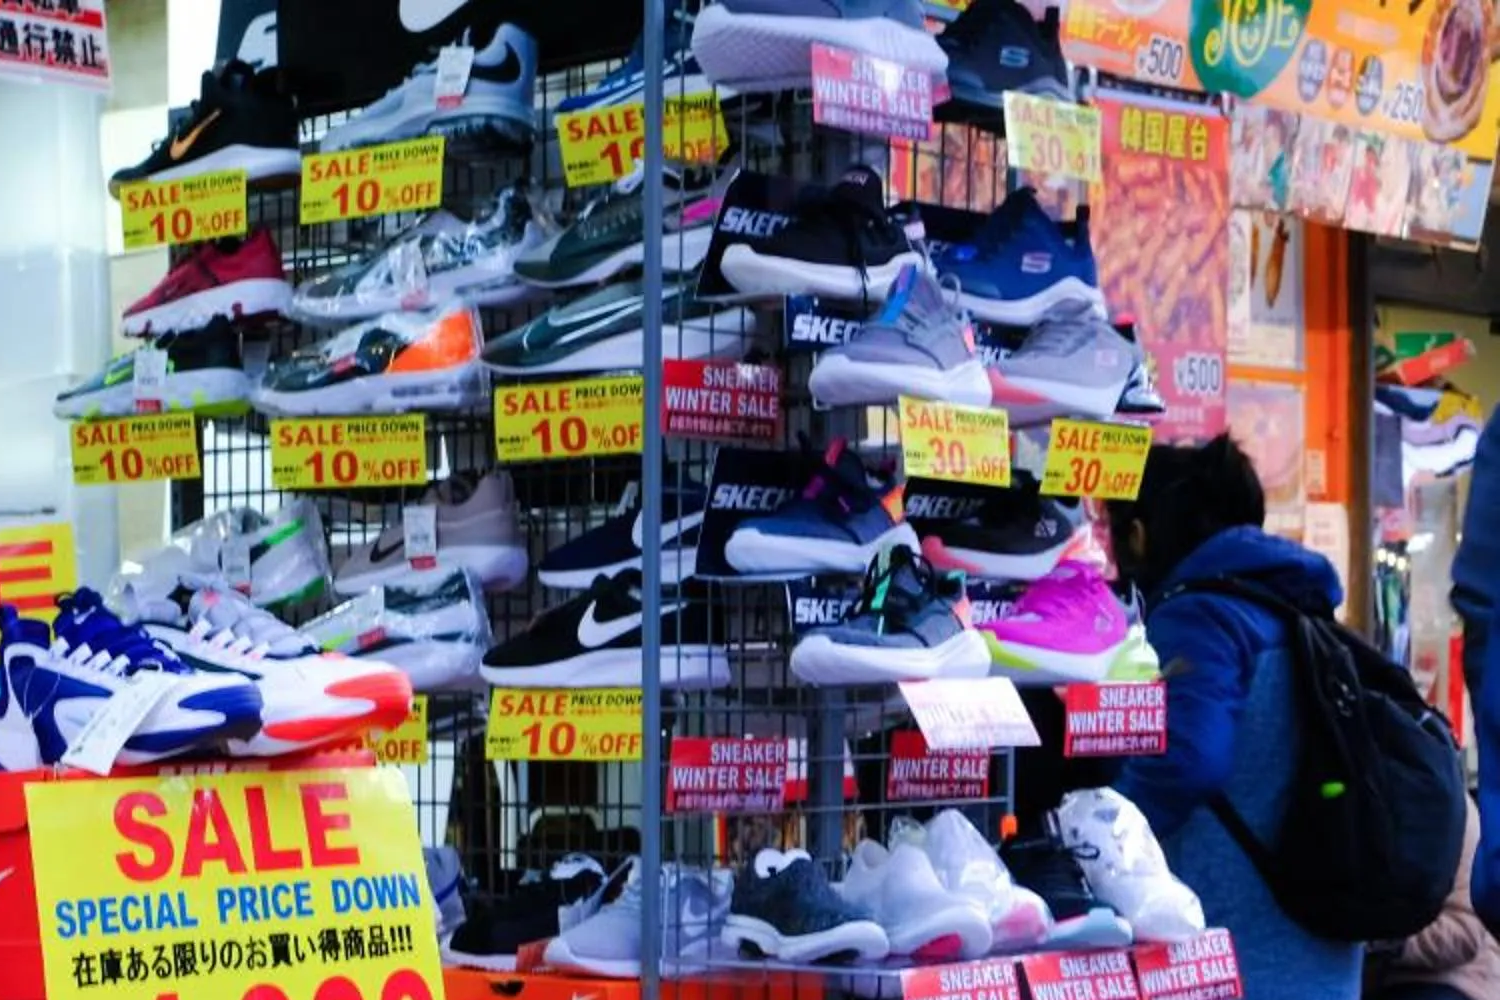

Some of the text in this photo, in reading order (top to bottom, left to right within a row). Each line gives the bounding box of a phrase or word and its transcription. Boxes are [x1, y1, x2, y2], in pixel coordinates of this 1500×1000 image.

[816, 76, 884, 111] WINTER
[567, 108, 638, 142] SALE
[310, 152, 371, 183] SALE
[127, 184, 181, 212] SALE
[332, 180, 436, 216] 10 %OFF
[150, 208, 243, 243] 10 %OFF
[503, 384, 642, 416] SALE PRICE DOW
[665, 388, 778, 418] WINTER SALE
[907, 405, 951, 432] SALE
[76, 423, 129, 447] SALE
[279, 424, 343, 447] SALE
[532, 417, 587, 455] 10
[592, 423, 640, 449] %OF
[1055, 427, 1100, 451] SALE
[100, 447, 196, 481] 10 %OFF
[304, 450, 420, 484] 10 %OFF
[929, 438, 966, 476] 30
[1065, 457, 1102, 494] 30
[500, 693, 569, 718] SALE
[1099, 687, 1165, 708] SNEAKER
[1069, 711, 1165, 732] WINTER SALE
[522, 721, 577, 758] 10
[711, 743, 786, 765] SNEAKER
[672, 765, 788, 791] WINTER SALE
[894, 757, 989, 780] WINTER SALE
[112, 781, 360, 884] SALE
[56, 873, 422, 939] SPECIAL PRICE DOWN
[72, 924, 414, 988] 在庫ある限りのお買い得商品!!!
[1168, 937, 1230, 962] SNEAKER
[940, 965, 1015, 993] SNEAKER
[1059, 954, 1128, 977] SNEAKER
[1142, 958, 1237, 993] WINTER SALE
[1097, 973, 1136, 999] SALE
